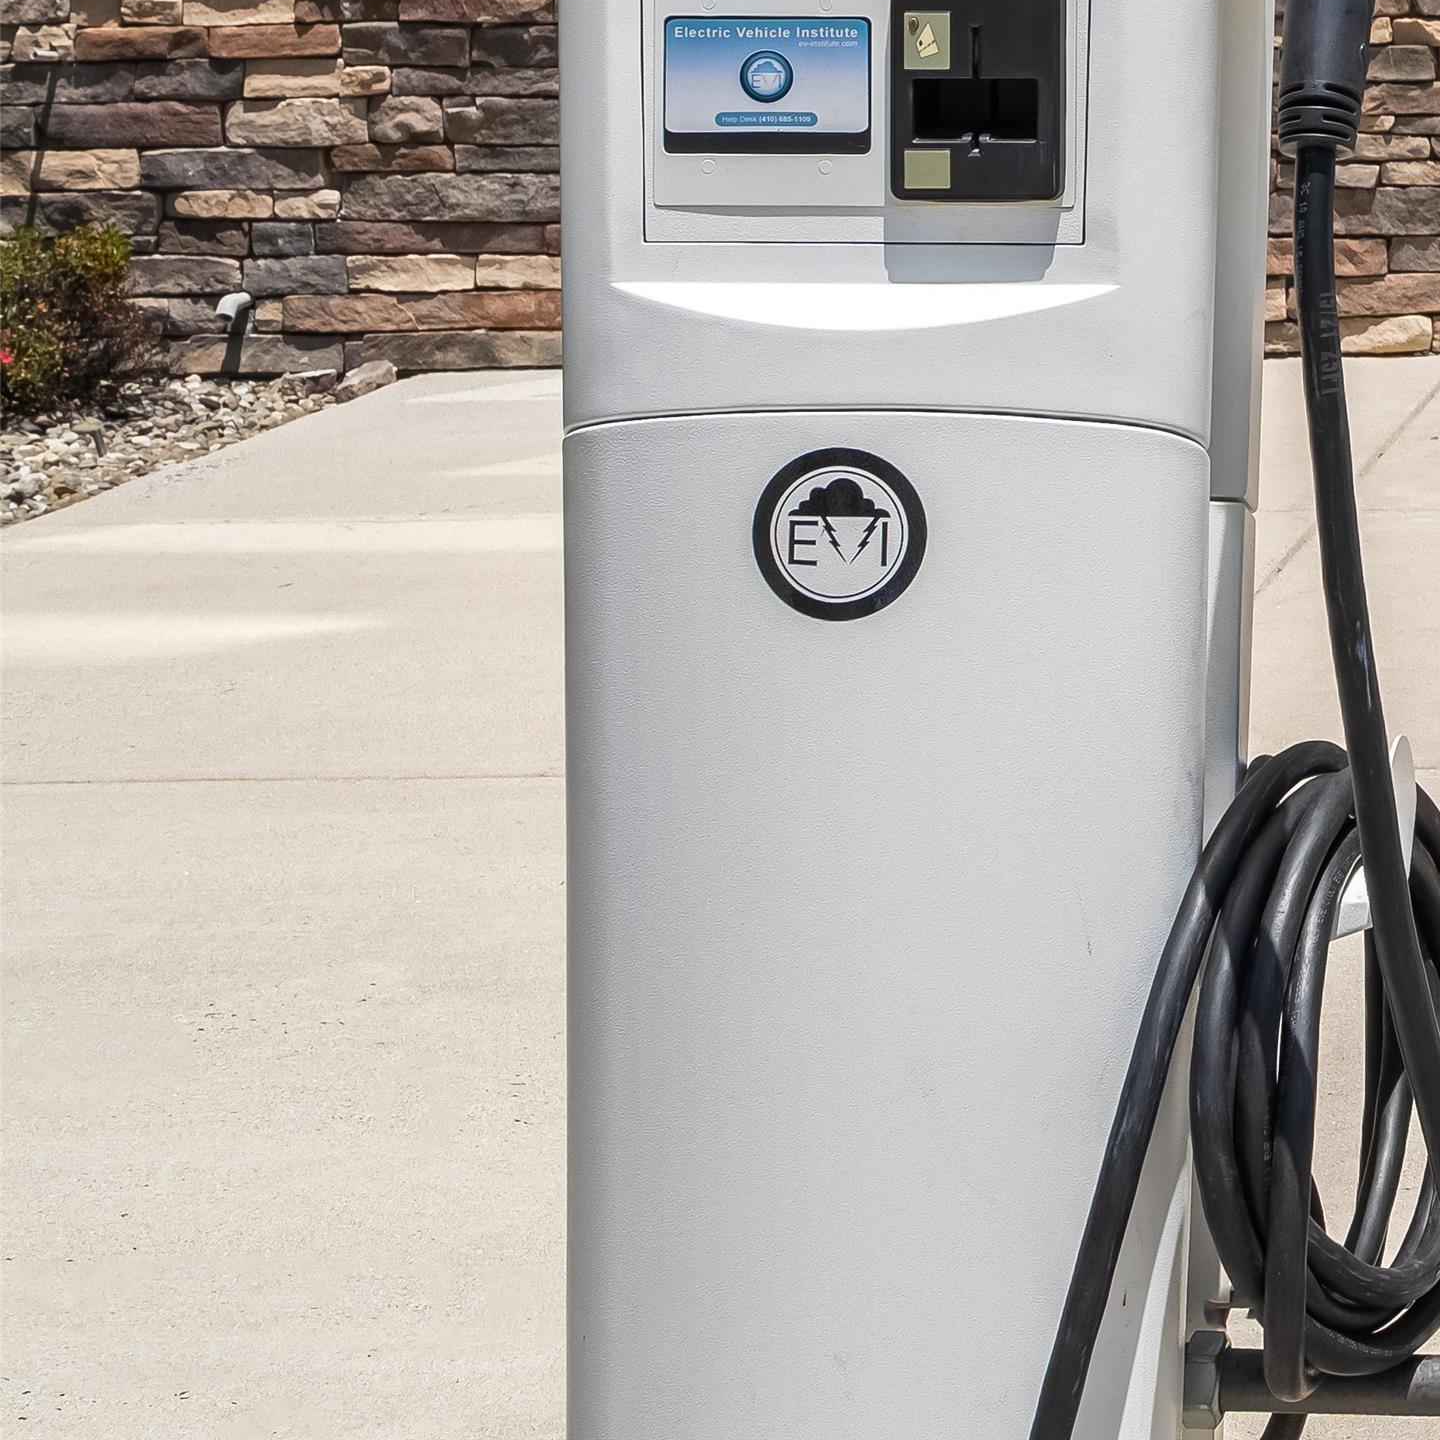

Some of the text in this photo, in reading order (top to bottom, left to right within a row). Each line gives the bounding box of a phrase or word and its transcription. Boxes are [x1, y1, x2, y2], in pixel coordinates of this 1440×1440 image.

[674, 26, 859, 38] Electric Vehicle Institute
[759, 116, 778, 124] (410)
